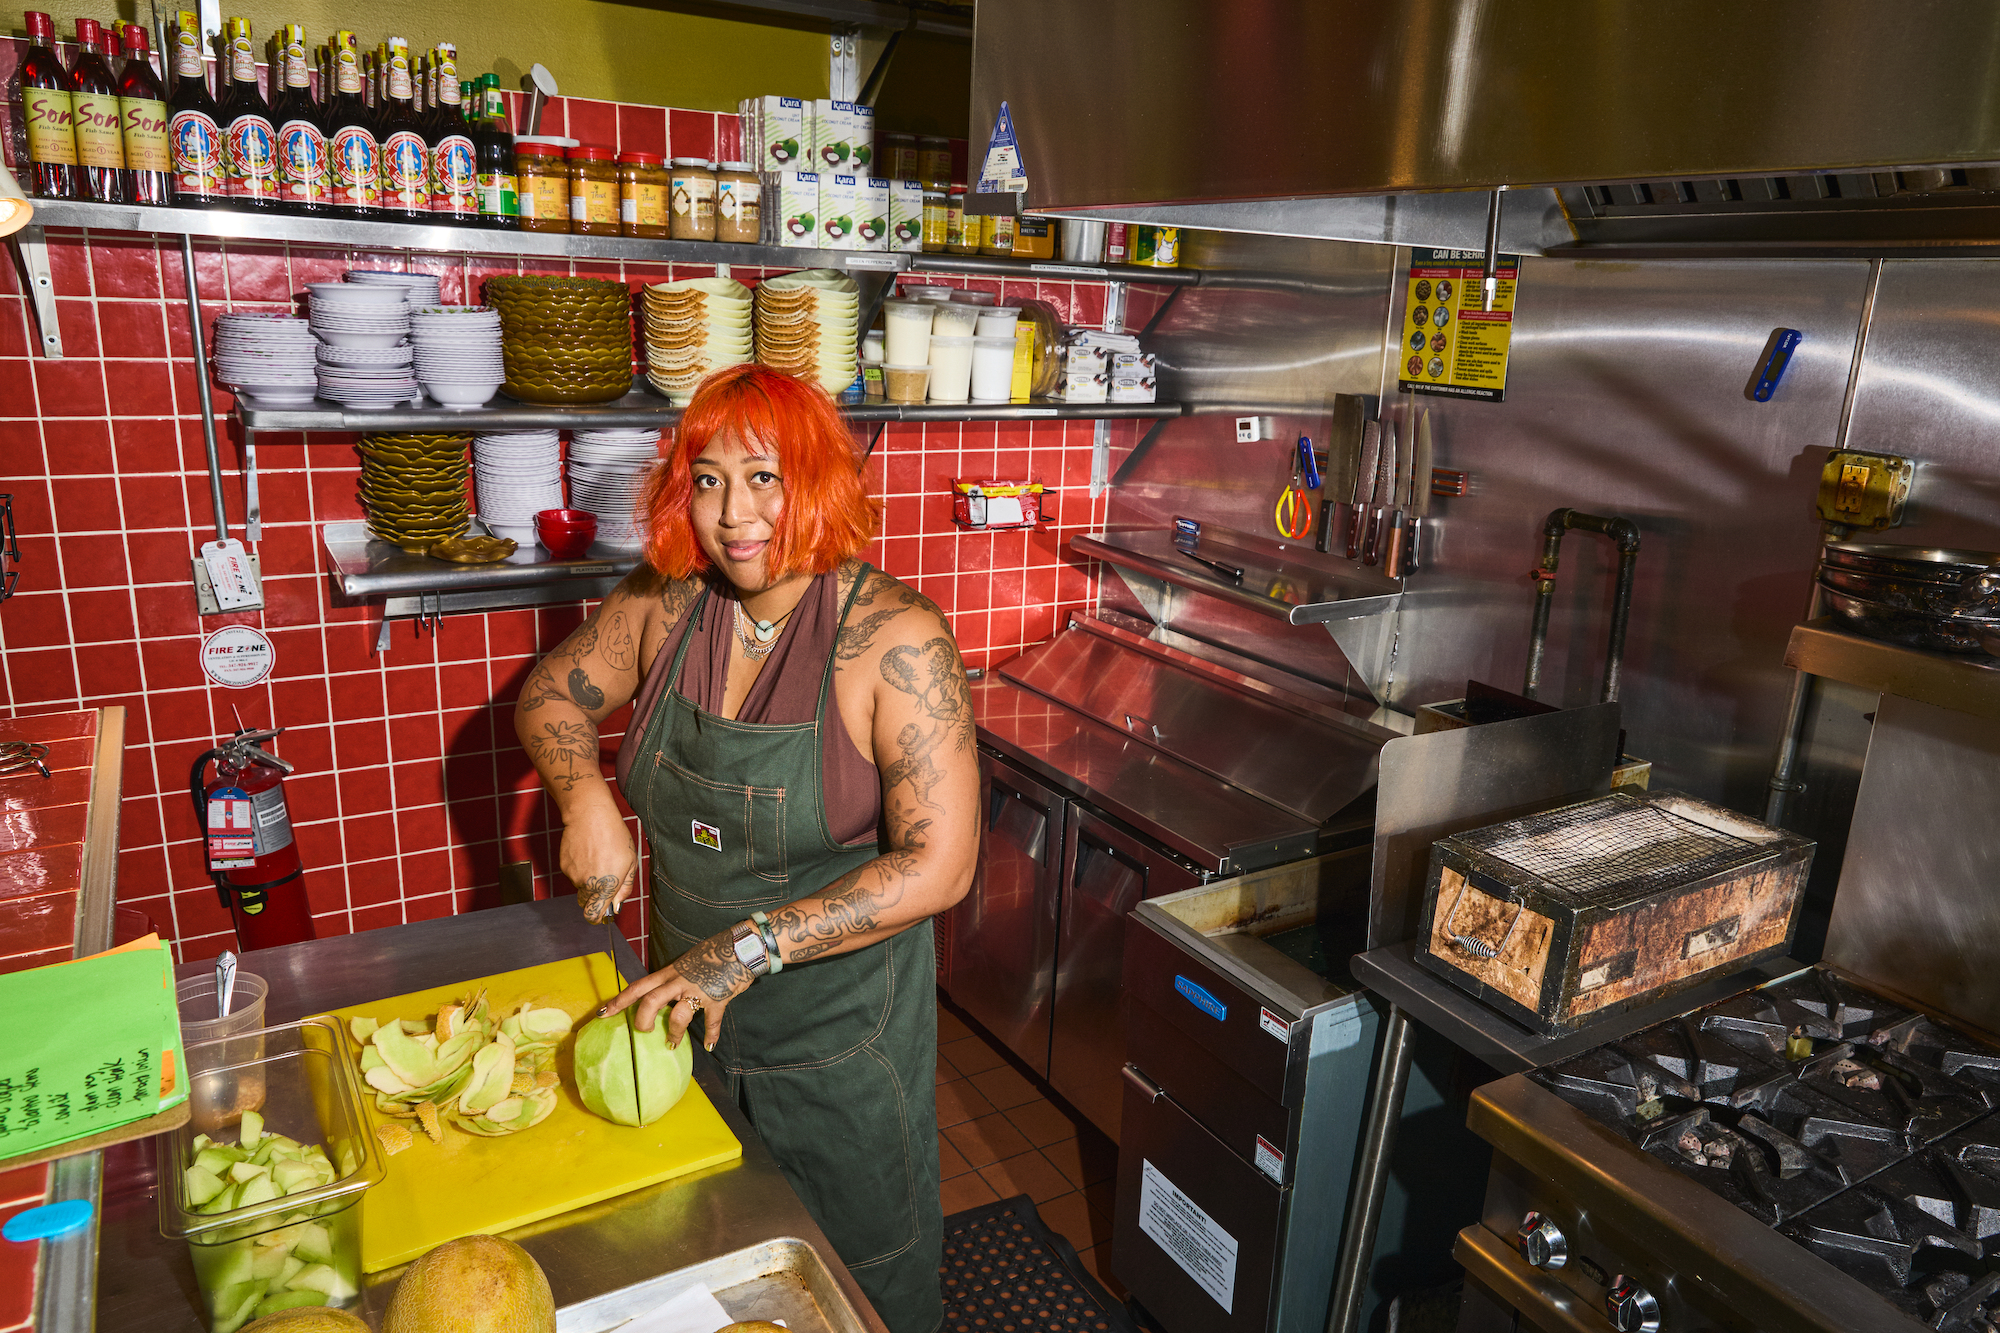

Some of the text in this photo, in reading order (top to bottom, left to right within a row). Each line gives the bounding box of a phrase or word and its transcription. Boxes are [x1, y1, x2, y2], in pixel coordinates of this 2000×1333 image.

[782, 98, 800, 108] kara
[833, 101, 851, 110] kara
[28, 99, 72, 125] Son
[76, 103, 118, 128] Son
[856, 106, 873, 115] kara
[125, 108, 166, 133] Son
[798, 173, 816, 182] kara
[836, 175, 854, 185] kara
[870, 179, 887, 188] kara
[906, 181, 921, 189] kara
[1433, 250, 1449, 259] CAN
[1450, 250, 1460, 259] BE
[229, 556, 240, 573] FIRE
[209, 644, 266, 655] FIRE ZONE
[1177, 980, 1221, 1016] SAPPHIRE
[1172, 1190, 1207, 1225] IMPORTANT!
